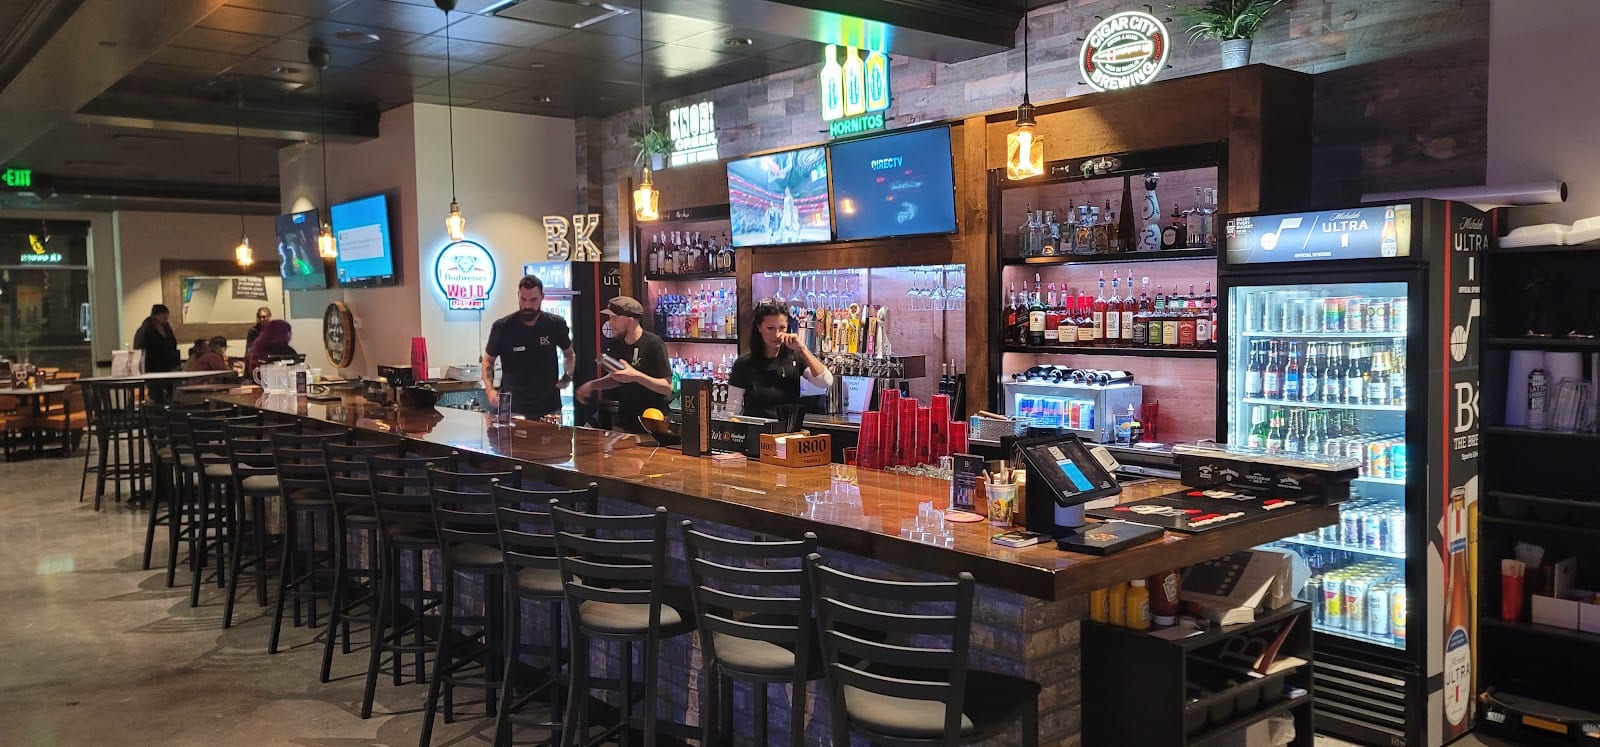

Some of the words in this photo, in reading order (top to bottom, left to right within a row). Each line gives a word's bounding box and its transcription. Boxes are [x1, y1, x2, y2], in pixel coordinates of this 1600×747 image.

[1090, 16, 1129, 48] CIGAR
[1129, 16, 1158, 37] CITY
[829, 114, 883, 136] HORNITOS
[871, 156, 903, 170] DIRECTV
[7, 168, 31, 186] EXIT
[1322, 220, 1368, 233] ULTRA
[543, 213, 602, 261] BK
[1454, 233, 1489, 252] ULTRA
[447, 284, 467, 298] We
[685, 395, 696, 410] BK
[797, 438, 827, 455] 1800
